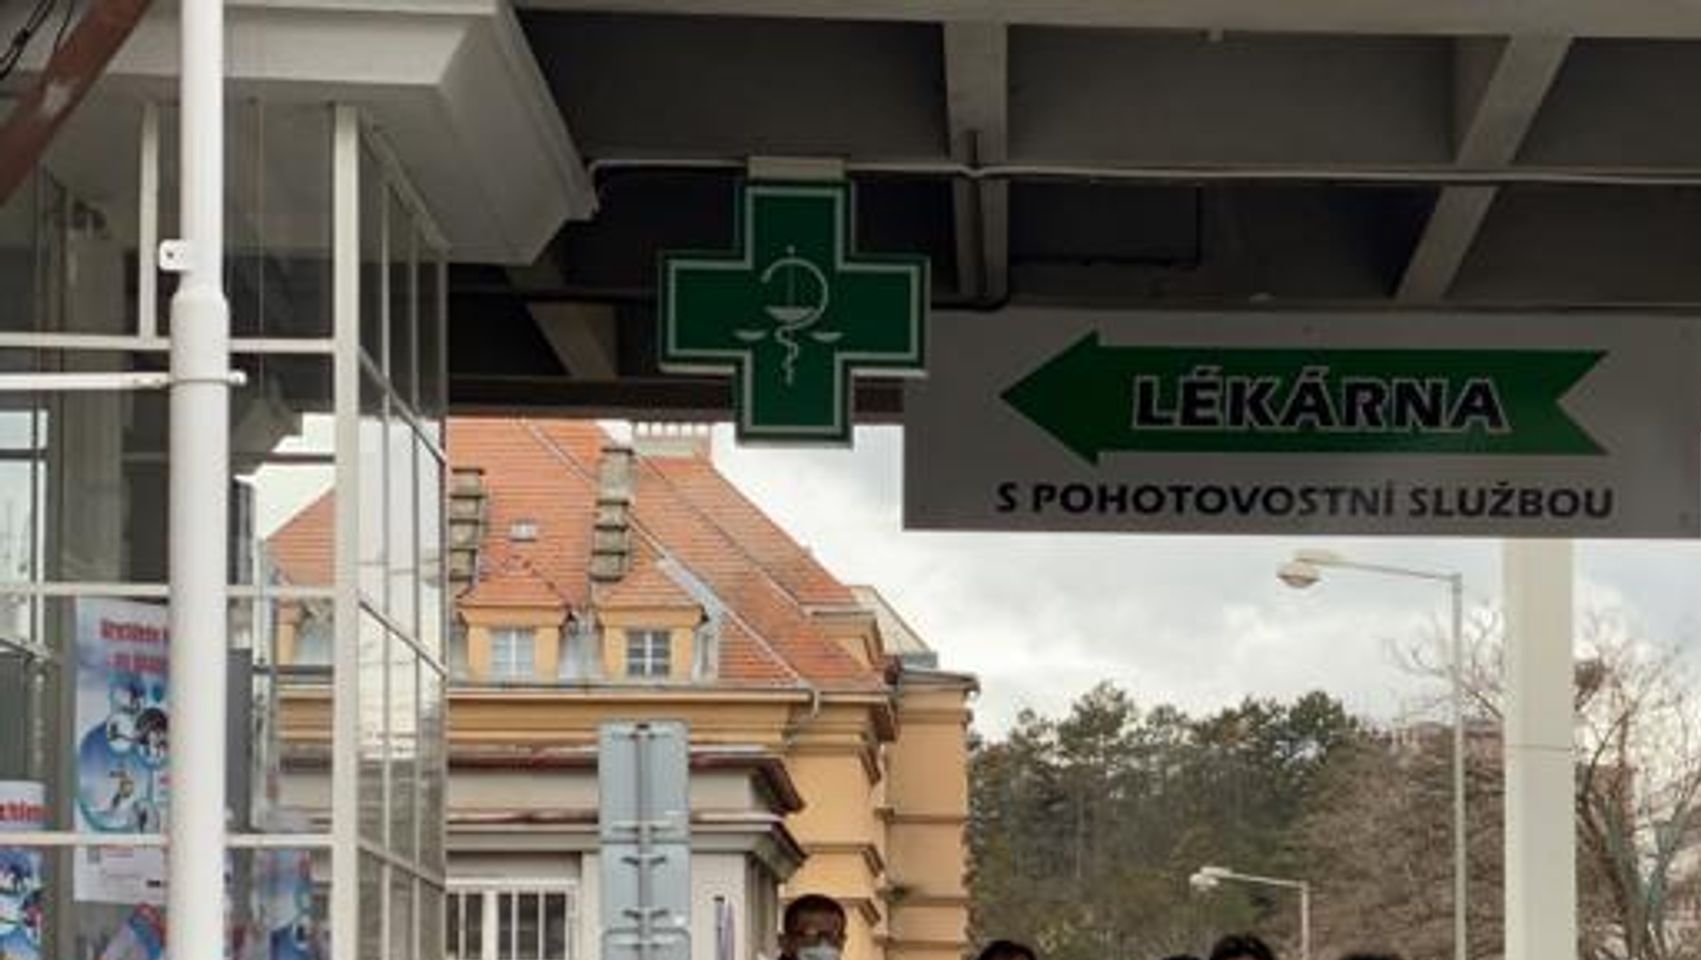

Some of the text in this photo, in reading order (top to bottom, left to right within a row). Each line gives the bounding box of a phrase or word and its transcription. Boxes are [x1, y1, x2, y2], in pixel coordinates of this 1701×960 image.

[1131, 365, 1513, 433] LÉKÁRNA
[996, 480, 1614, 520] S POHOTOVOSTNÍ SLUŽBOU
